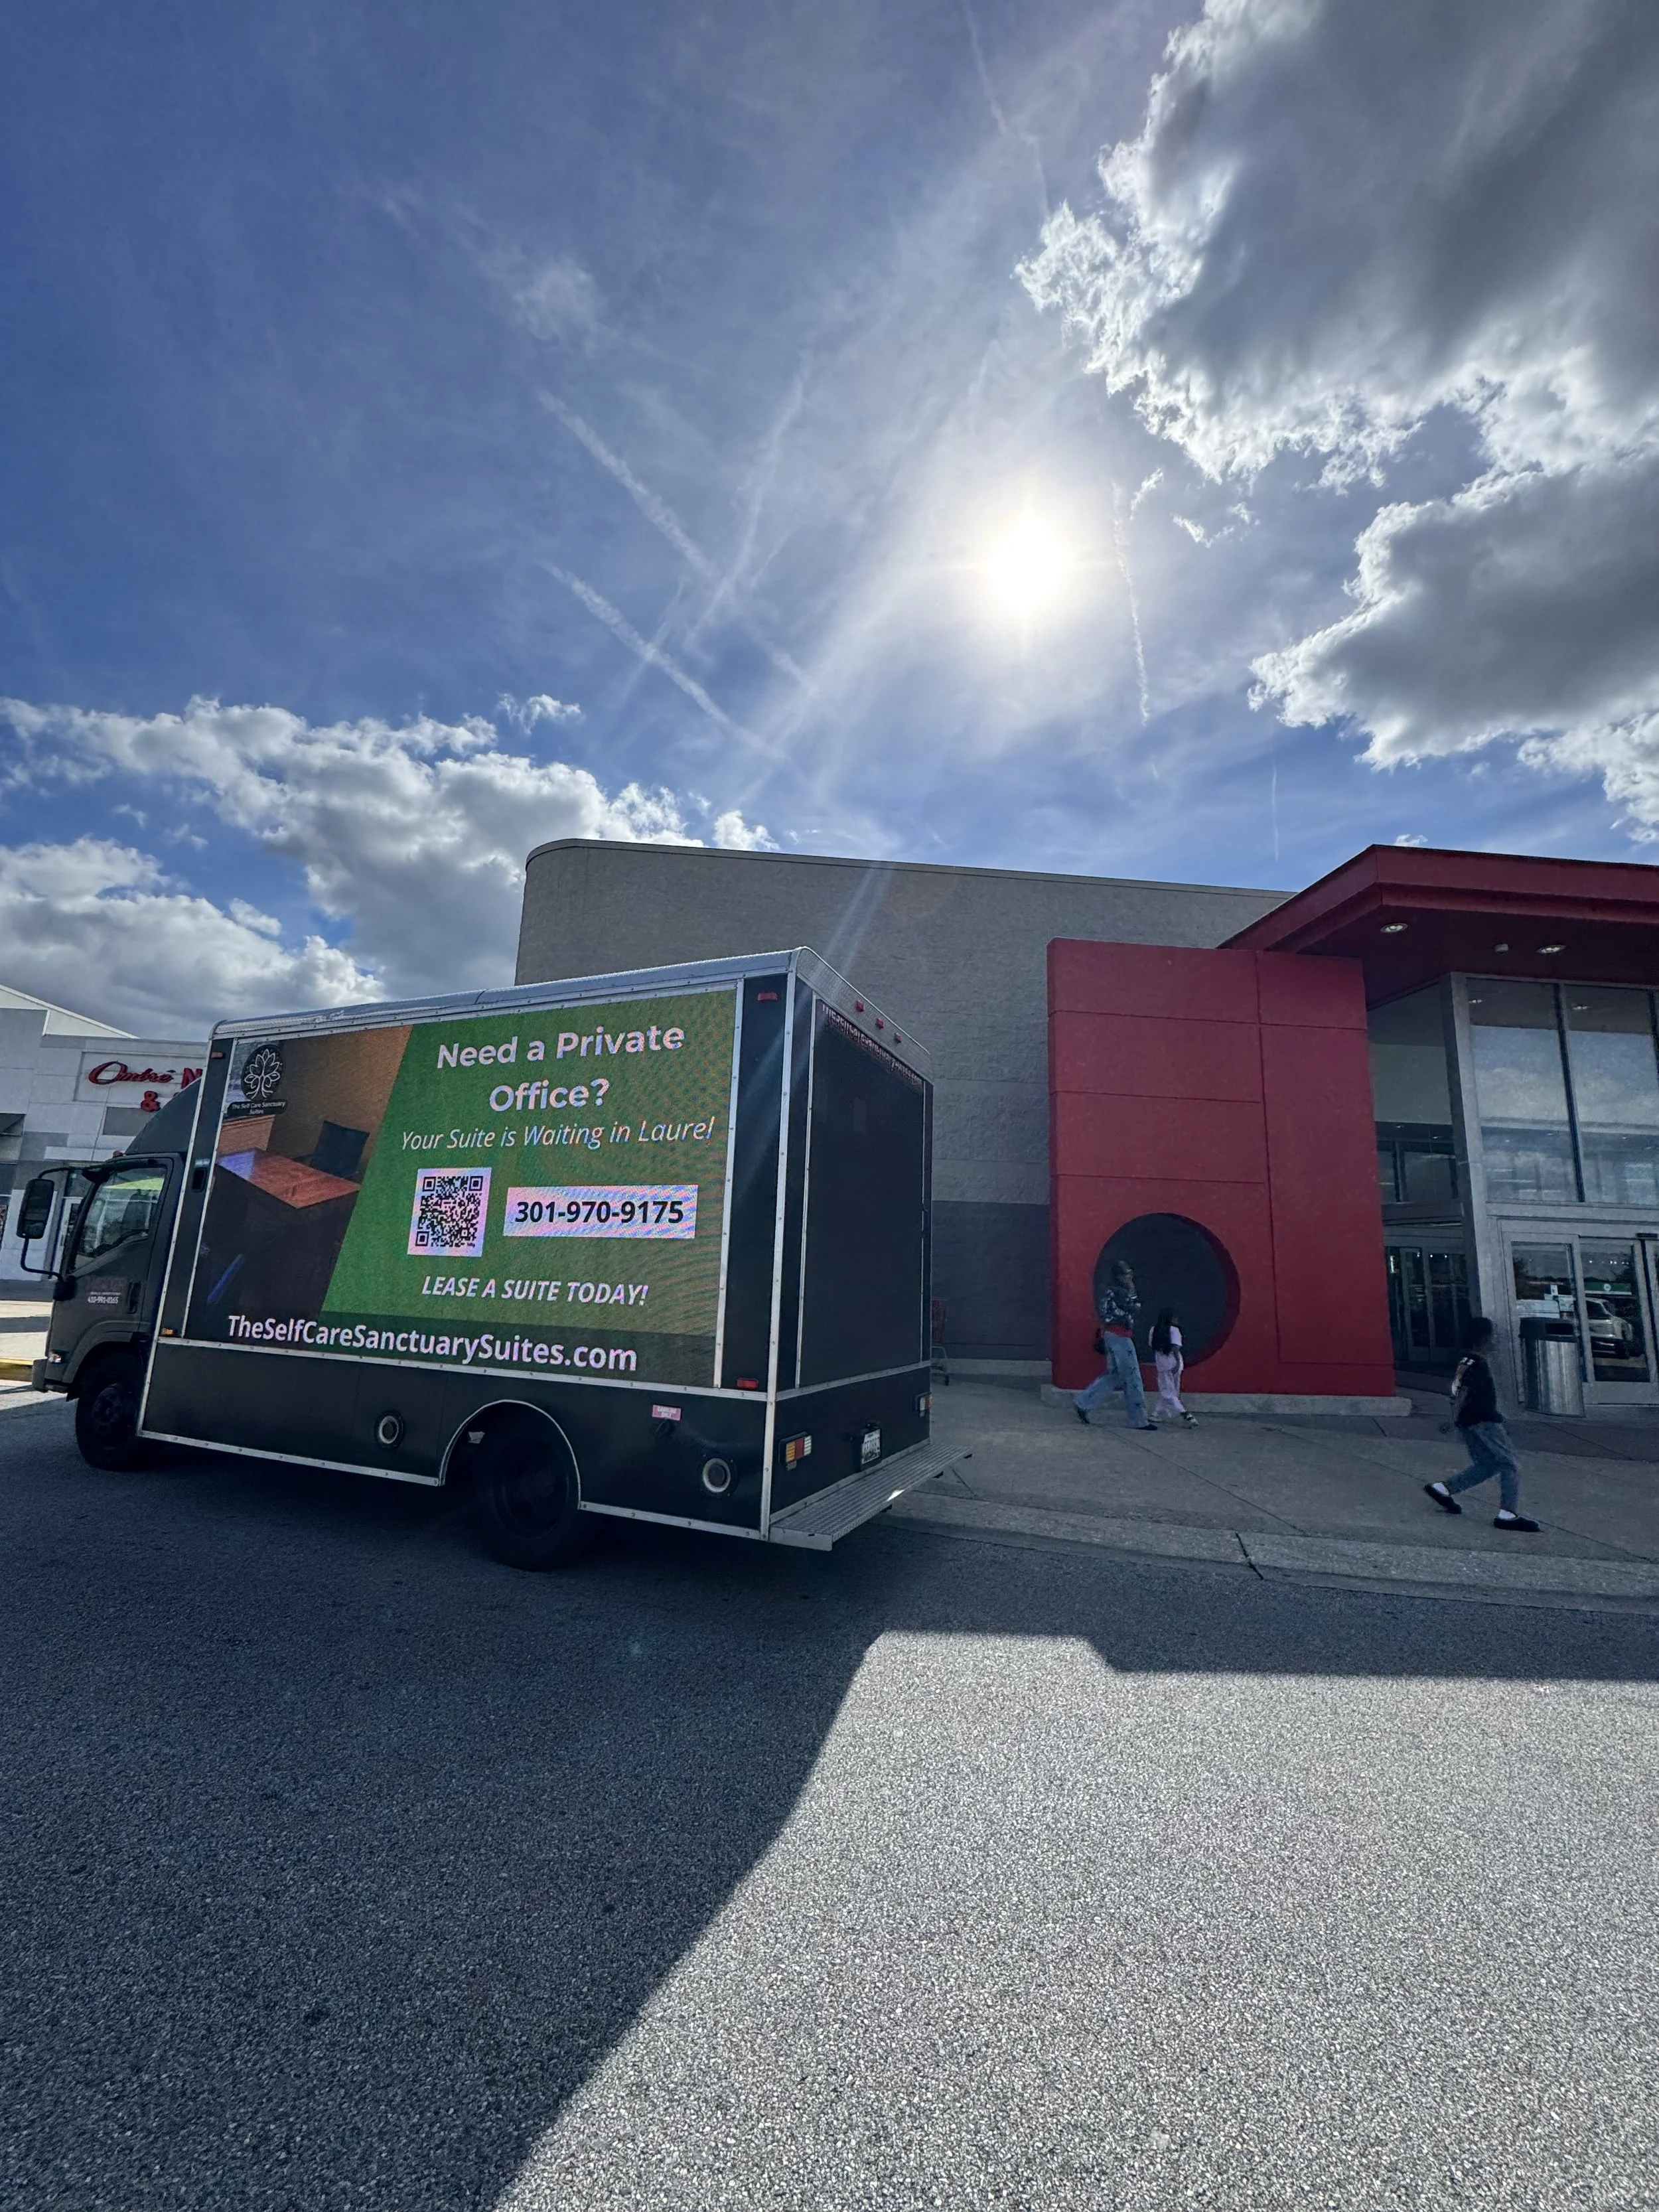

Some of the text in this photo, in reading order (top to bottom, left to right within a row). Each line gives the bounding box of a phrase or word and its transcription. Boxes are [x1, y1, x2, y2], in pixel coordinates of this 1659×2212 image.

[437, 1025, 685, 1069] Need a Private
[140, 1090, 161, 1112] &
[489, 1078, 610, 1112] Office?
[401, 1116, 716, 1150] Your Suite is Waiting in Laurel
[515, 1201, 684, 1224] 301-970-9175
[421, 1276, 650, 1306] LEASE A SUITE TODAY!
[228, 1315, 638, 1371] TheSelfCareSanctuarySuites.com
